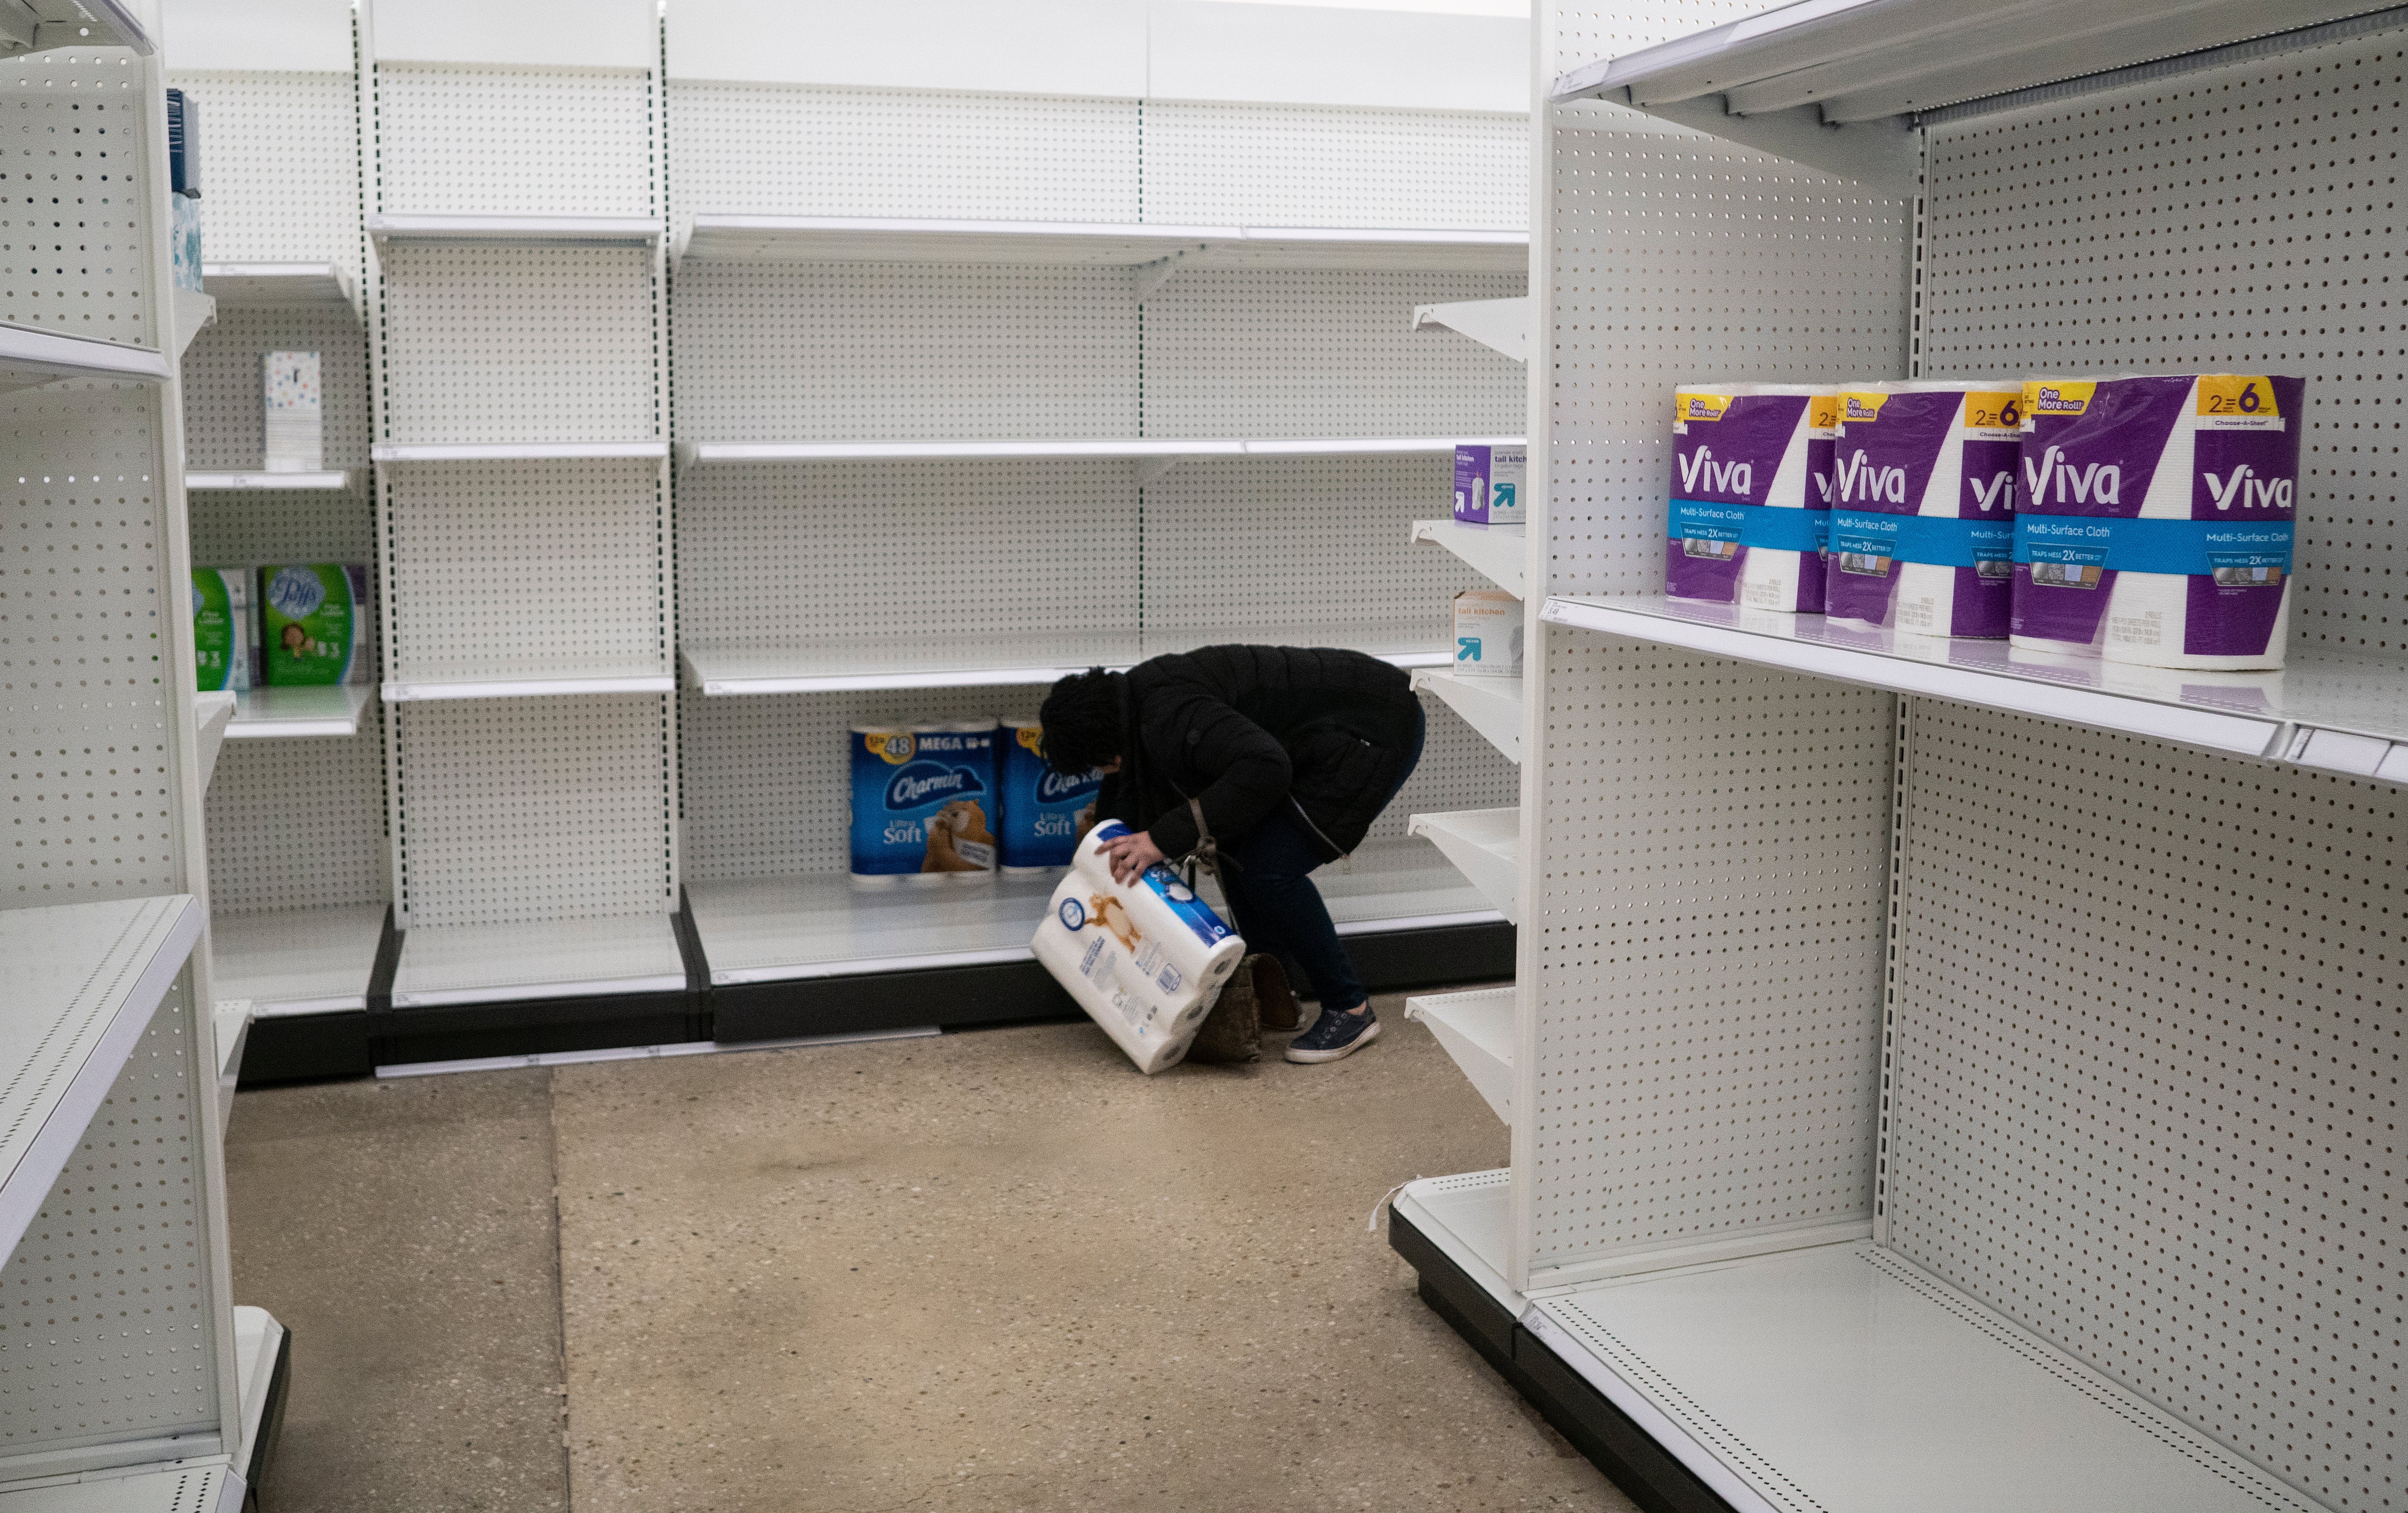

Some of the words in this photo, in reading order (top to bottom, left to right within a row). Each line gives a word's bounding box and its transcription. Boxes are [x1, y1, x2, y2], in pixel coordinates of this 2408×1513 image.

[2040, 388, 2059, 399] One
[1690, 398, 1705, 408] One
[1848, 398, 1860, 408] One
[2039, 400, 2062, 410] More
[1689, 408, 1706, 416] More
[1847, 408, 1863, 417] More
[1678, 445, 1751, 495] Viva
[1836, 449, 1905, 504] Viva
[2024, 445, 2121, 506] Viva
[2203, 464, 2293, 510] Viva
[1680, 507, 1724, 518] Multi-Surface
[1726, 510, 1744, 520] Cloth
[1837, 518, 1879, 530] Multi-Surface
[1880, 521, 1897, 532] Cloth
[2027, 524, 2083, 536] Multi-Surface
[2086, 526, 2110, 537] Cloth
[1708, 529, 1718, 538] 2X
[2206, 533, 2269, 542] Multi-Surface
[1862, 541, 1872, 552] 2X
[2062, 549, 2076, 561] 2X
[2249, 556, 2262, 565] 2X
[885, 737, 910, 754] 48
[919, 737, 962, 750] MEGA
[894, 769, 962, 803] Charmin
[1034, 819, 1071, 837] Soft
[883, 826, 921, 844] Soft
